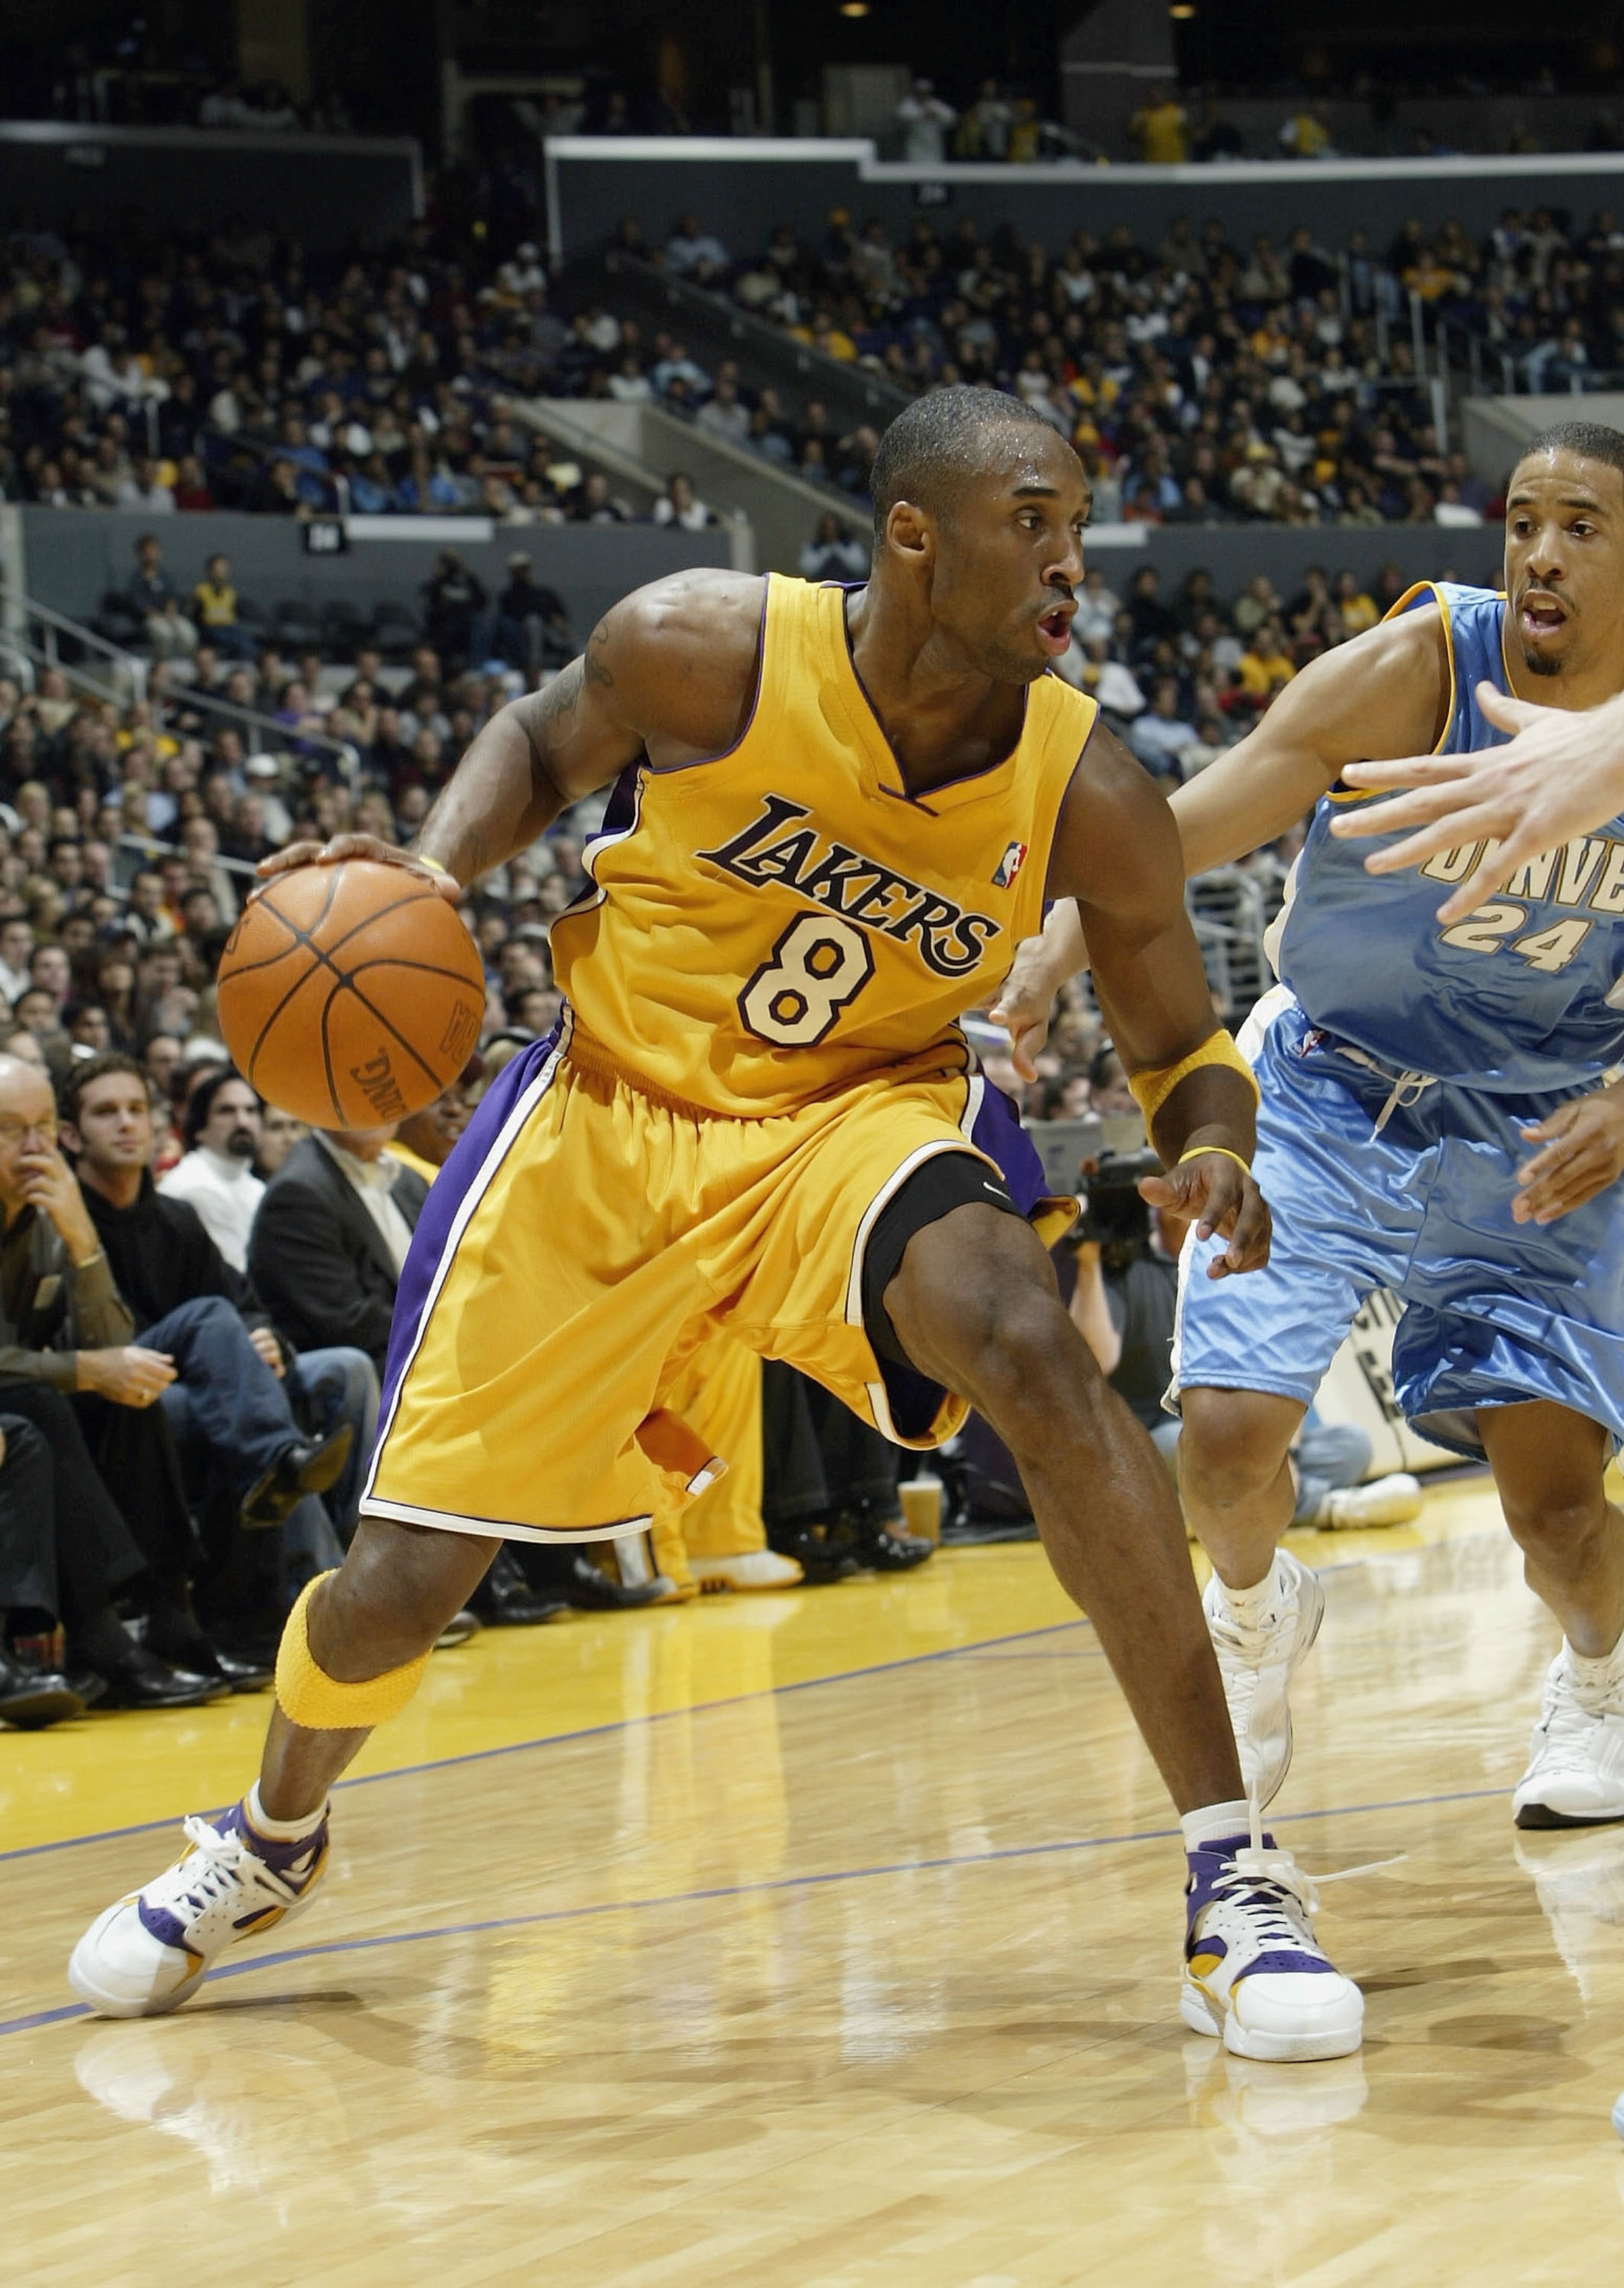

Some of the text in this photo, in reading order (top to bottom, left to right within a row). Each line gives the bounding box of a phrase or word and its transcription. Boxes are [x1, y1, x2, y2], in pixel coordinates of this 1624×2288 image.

[693, 791, 1005, 980] LAKERS
[1436, 902, 1593, 975] 24
[737, 910, 876, 1048] 8
